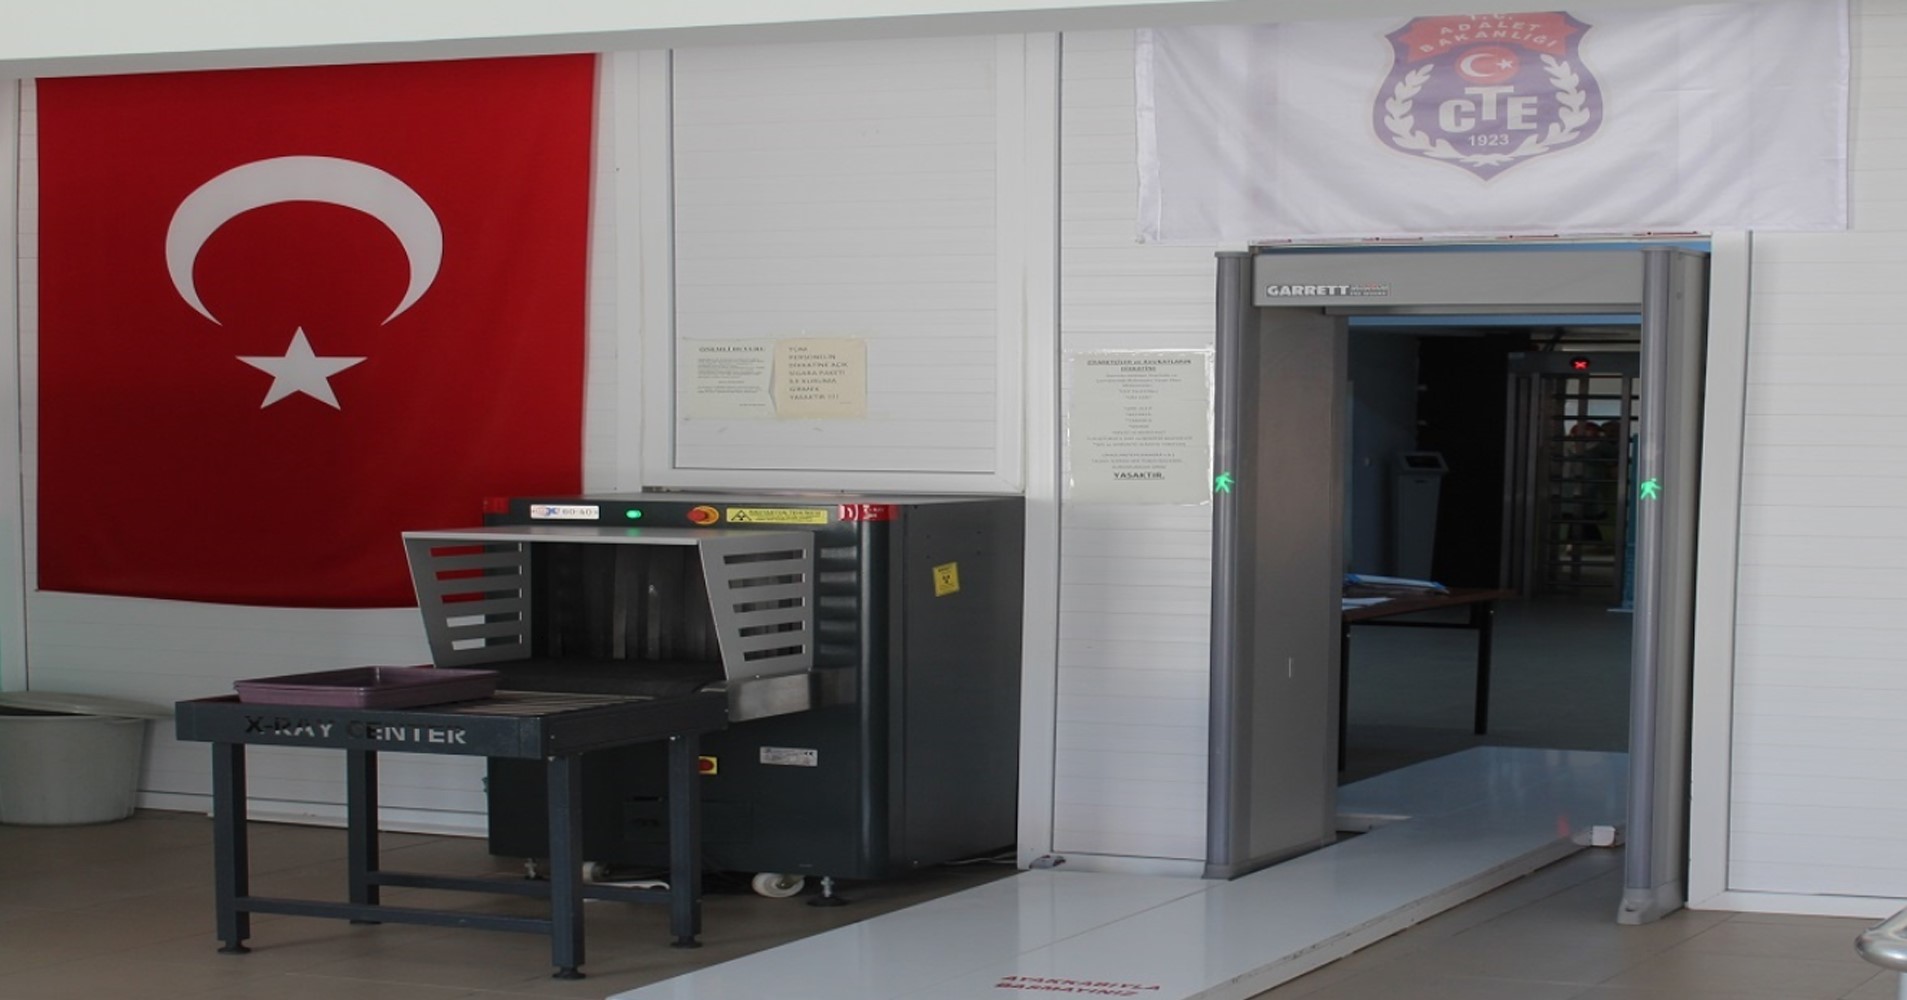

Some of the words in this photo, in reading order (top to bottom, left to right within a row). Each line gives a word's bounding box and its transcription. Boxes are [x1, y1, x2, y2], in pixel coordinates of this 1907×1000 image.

[1440, 21, 1542, 35] ADALET
[1438, 85, 1538, 133] CTE
[1467, 133, 1510, 147] 1923
[1266, 285, 1350, 297] GARRETT
[244, 714, 334, 738] X-RAY
[347, 719, 468, 744] CENTER
